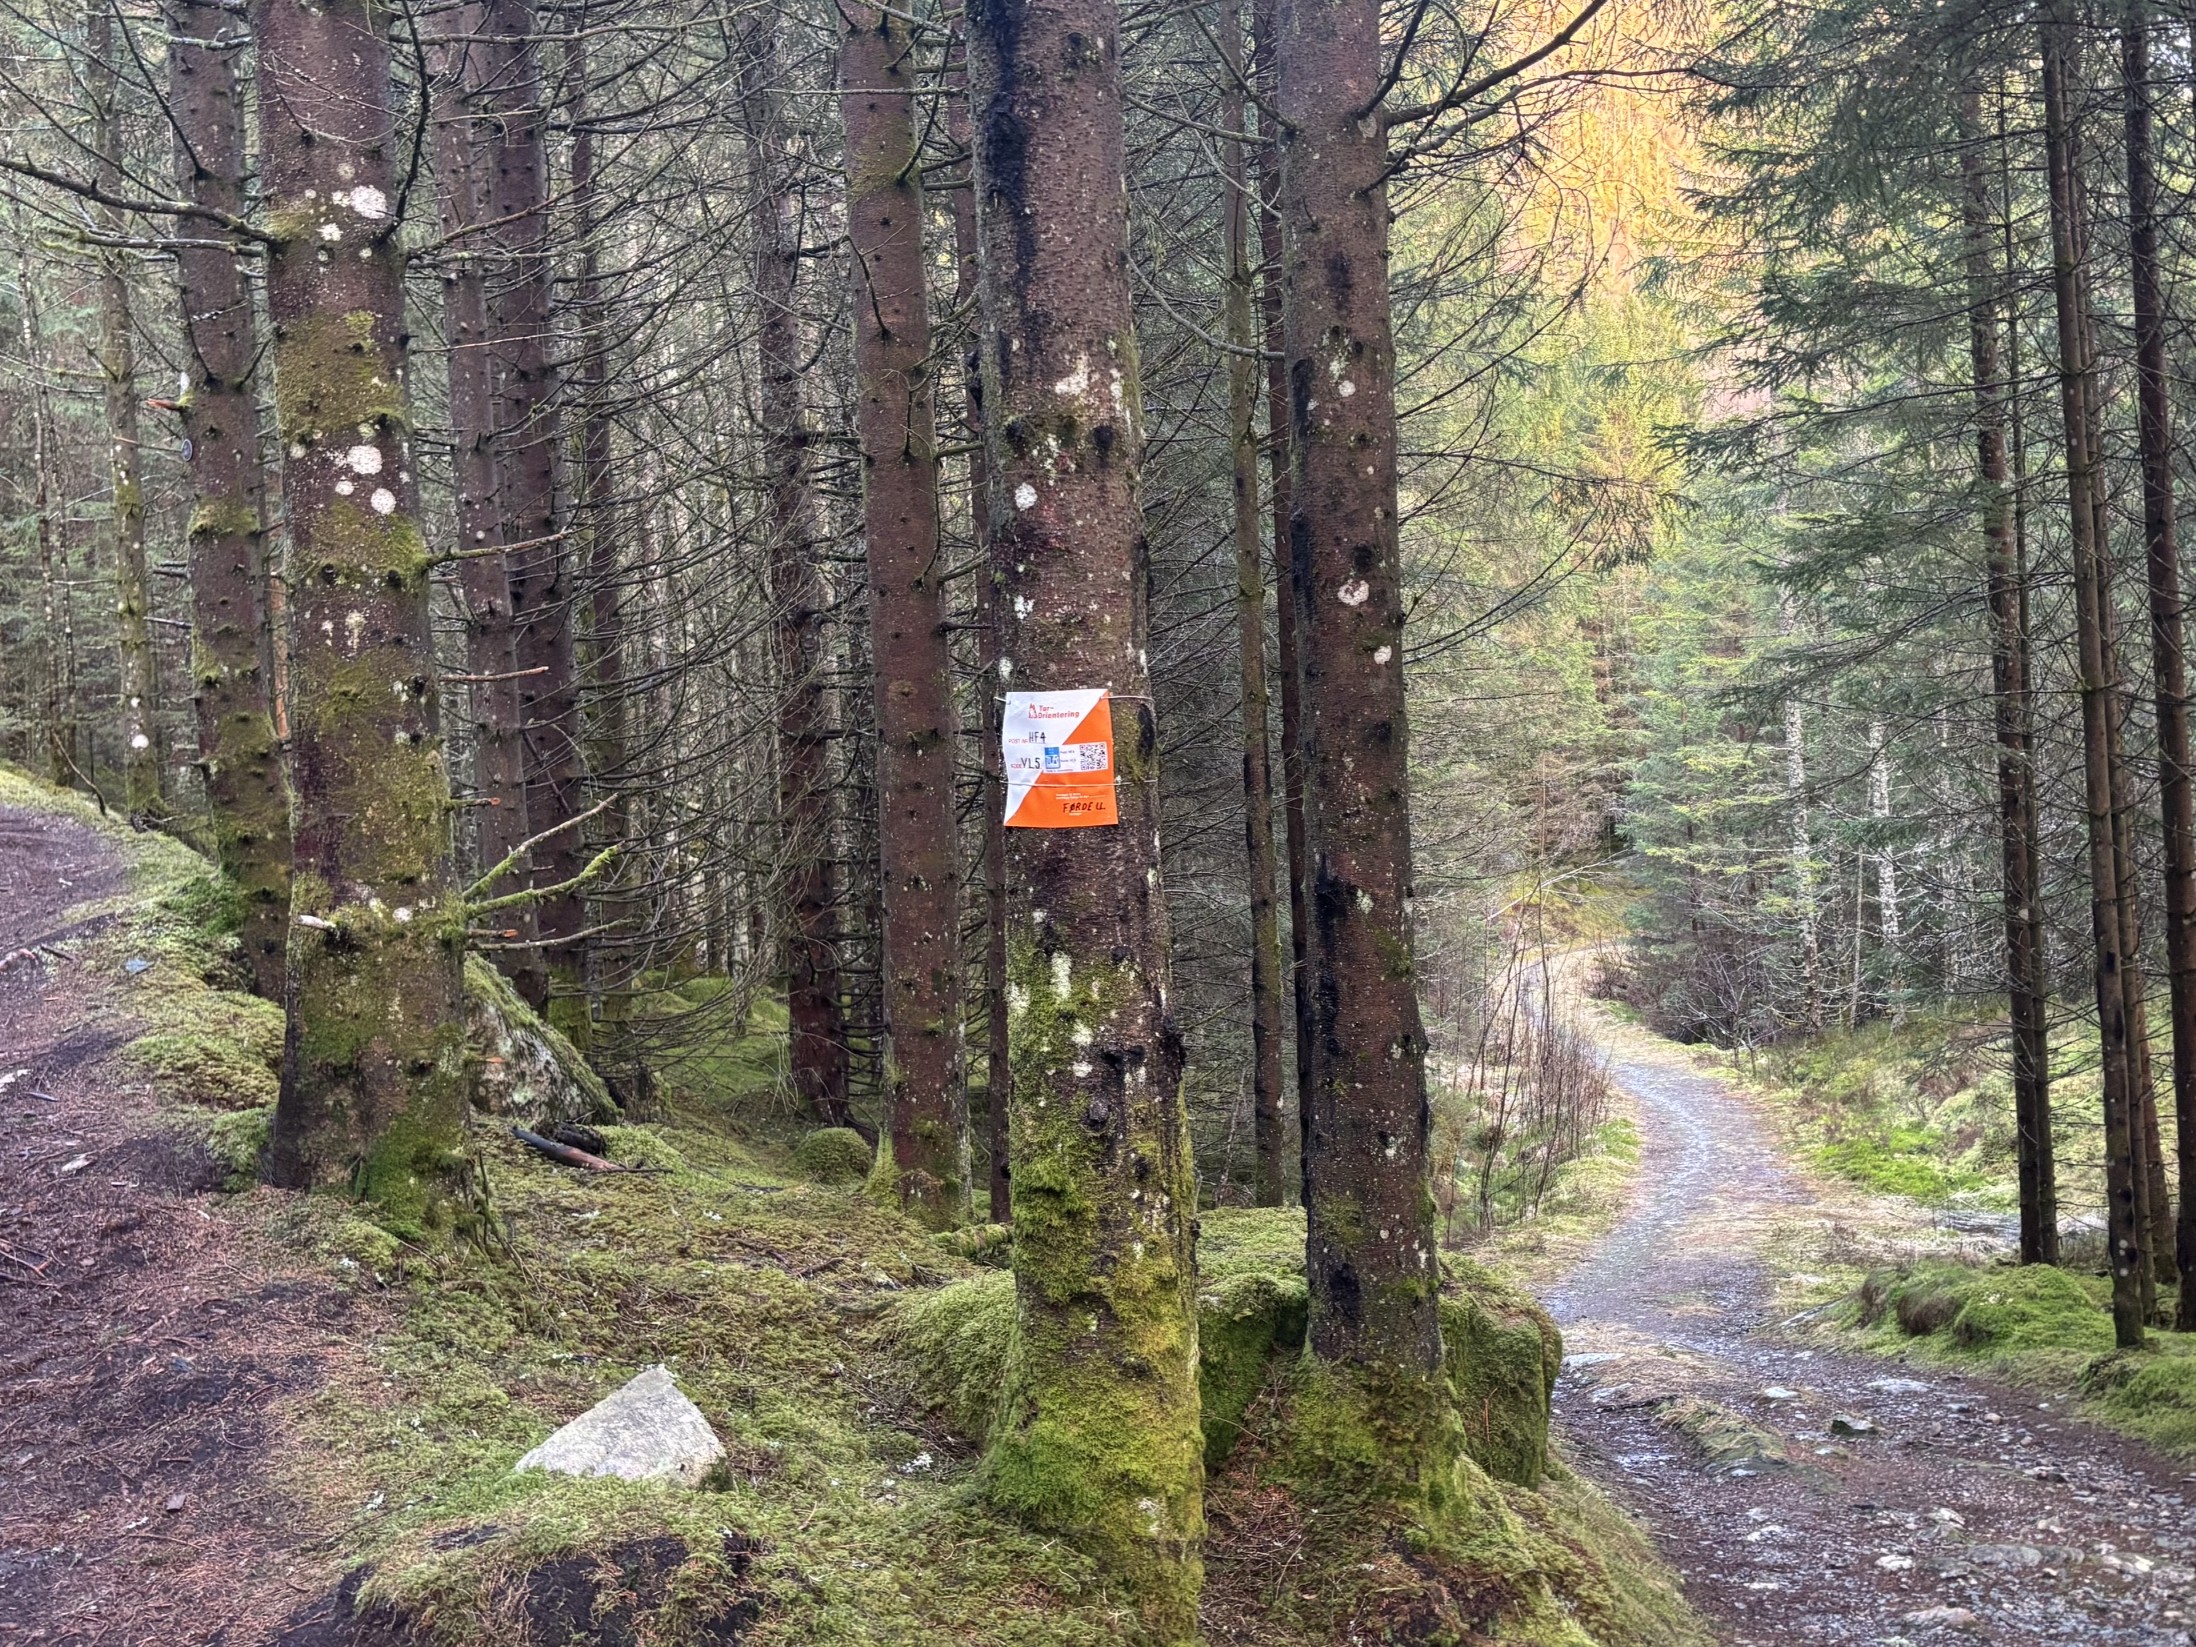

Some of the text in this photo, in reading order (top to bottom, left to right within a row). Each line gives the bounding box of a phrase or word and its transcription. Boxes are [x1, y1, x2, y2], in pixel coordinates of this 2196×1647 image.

[1038, 711, 1080, 719] Orientering
[1029, 731, 1046, 744] HF4
[1021, 757, 1041, 769] VL5
[1063, 802, 1093, 813] FØRDE
